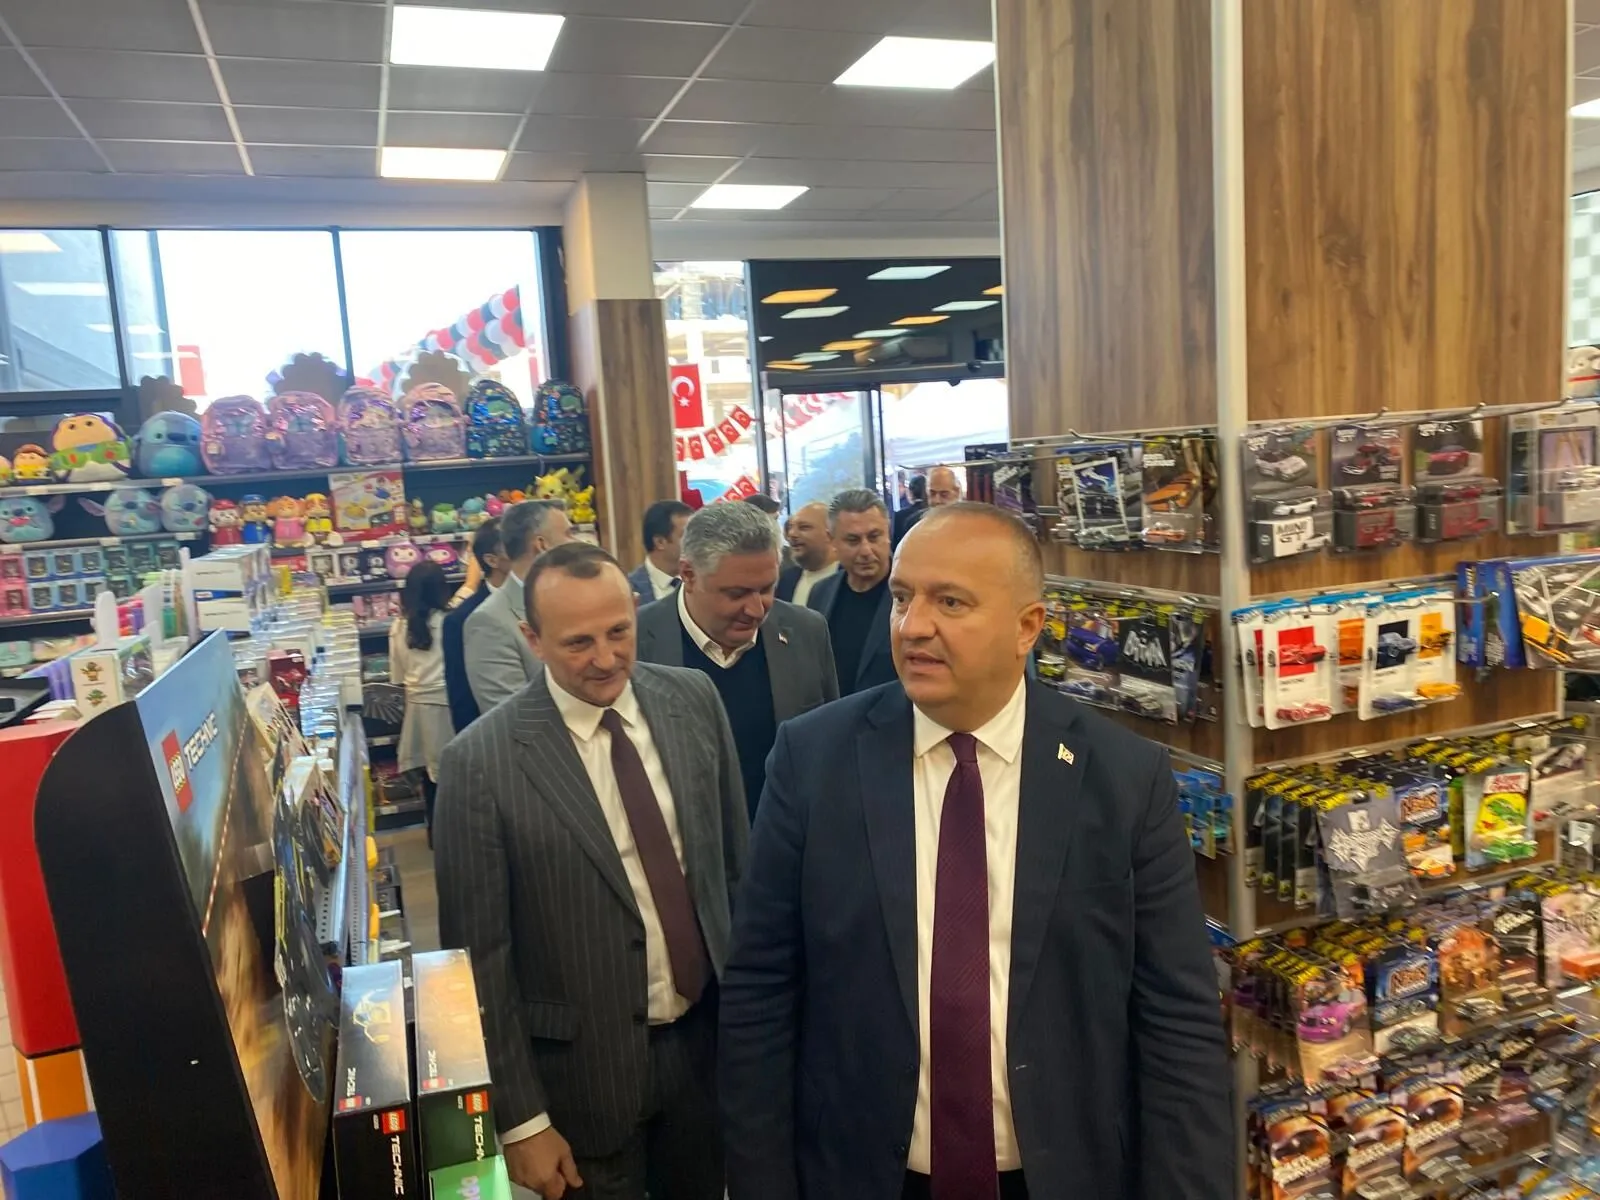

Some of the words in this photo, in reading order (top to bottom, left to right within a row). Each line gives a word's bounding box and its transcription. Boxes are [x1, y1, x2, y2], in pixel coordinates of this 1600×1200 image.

[1276, 521, 1308, 534] MINI
[1279, 534, 1302, 543] GT
[183, 712, 219, 771] TECHNIC
[388, 1112, 399, 1132] LEGO
[473, 1115, 485, 1161] TECHN
[390, 1135, 405, 1195] TECHNIC
